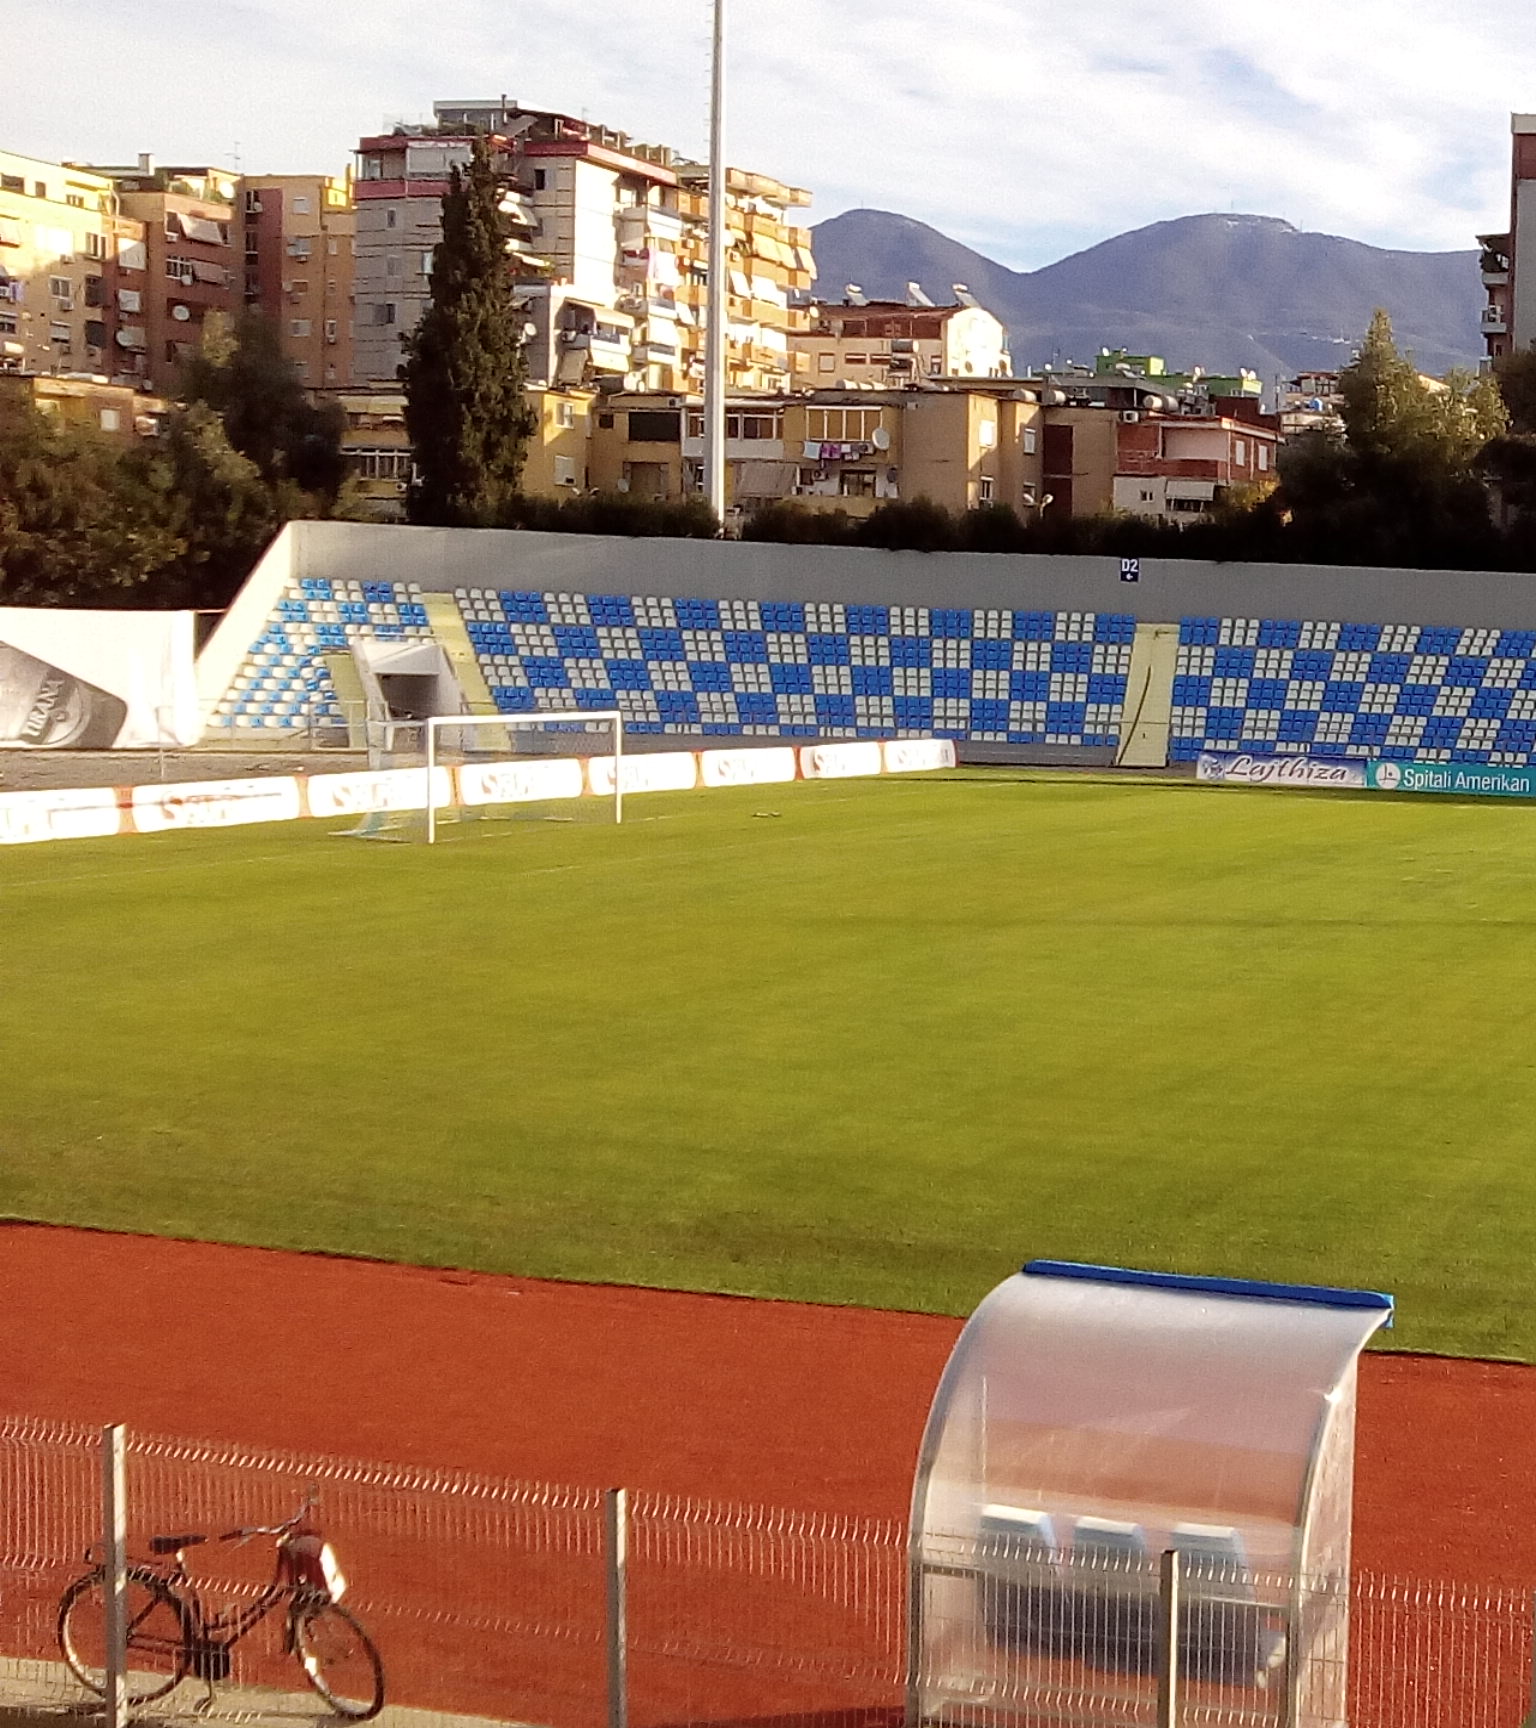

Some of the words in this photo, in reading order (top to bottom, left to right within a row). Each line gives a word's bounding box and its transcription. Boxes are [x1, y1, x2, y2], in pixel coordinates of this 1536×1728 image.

[1121, 559, 1138, 571] D2
[1225, 755, 1347, 783] Lajthiza
[1403, 768, 1451, 789] Spitali
[1454, 771, 1530, 792] Amerikan
